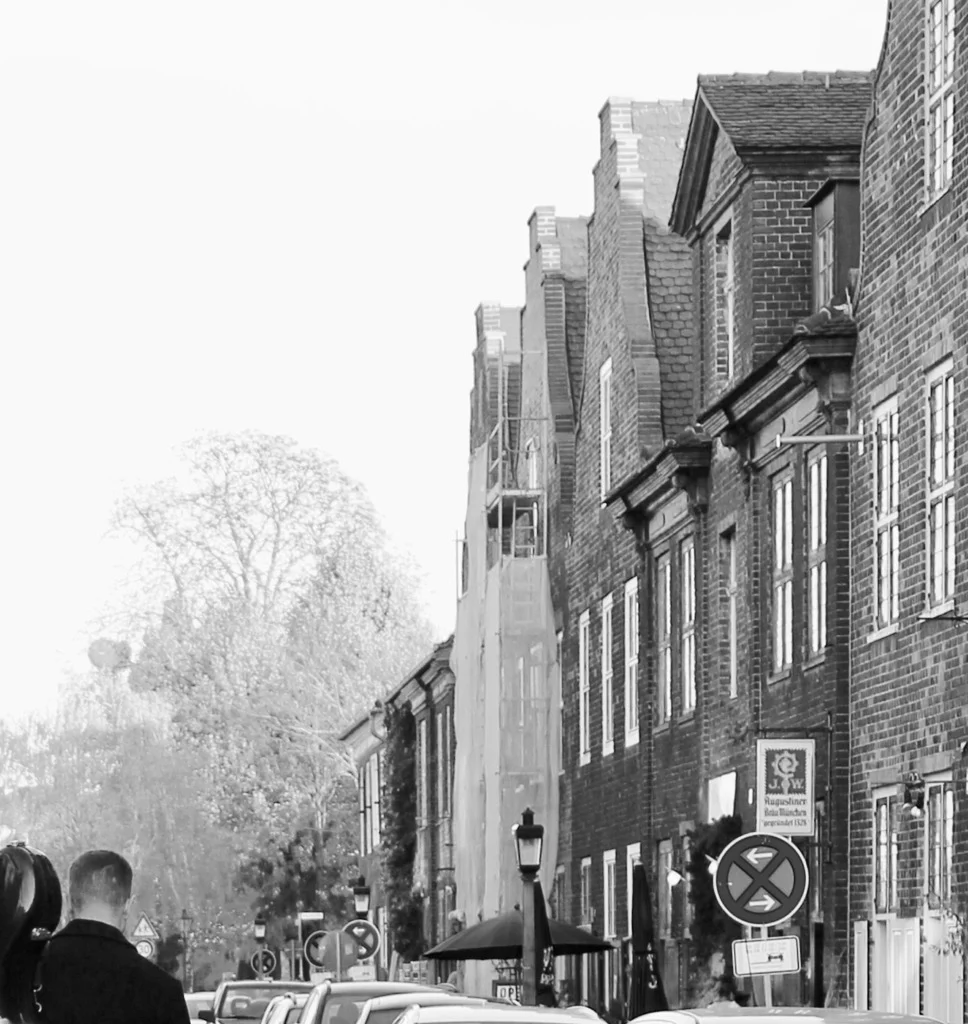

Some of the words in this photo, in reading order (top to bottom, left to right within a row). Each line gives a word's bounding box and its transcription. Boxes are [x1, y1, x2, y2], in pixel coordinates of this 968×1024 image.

[768, 778, 781, 789] J.
[790, 778, 805, 789] W.
[764, 796, 807, 807] Augustiner
